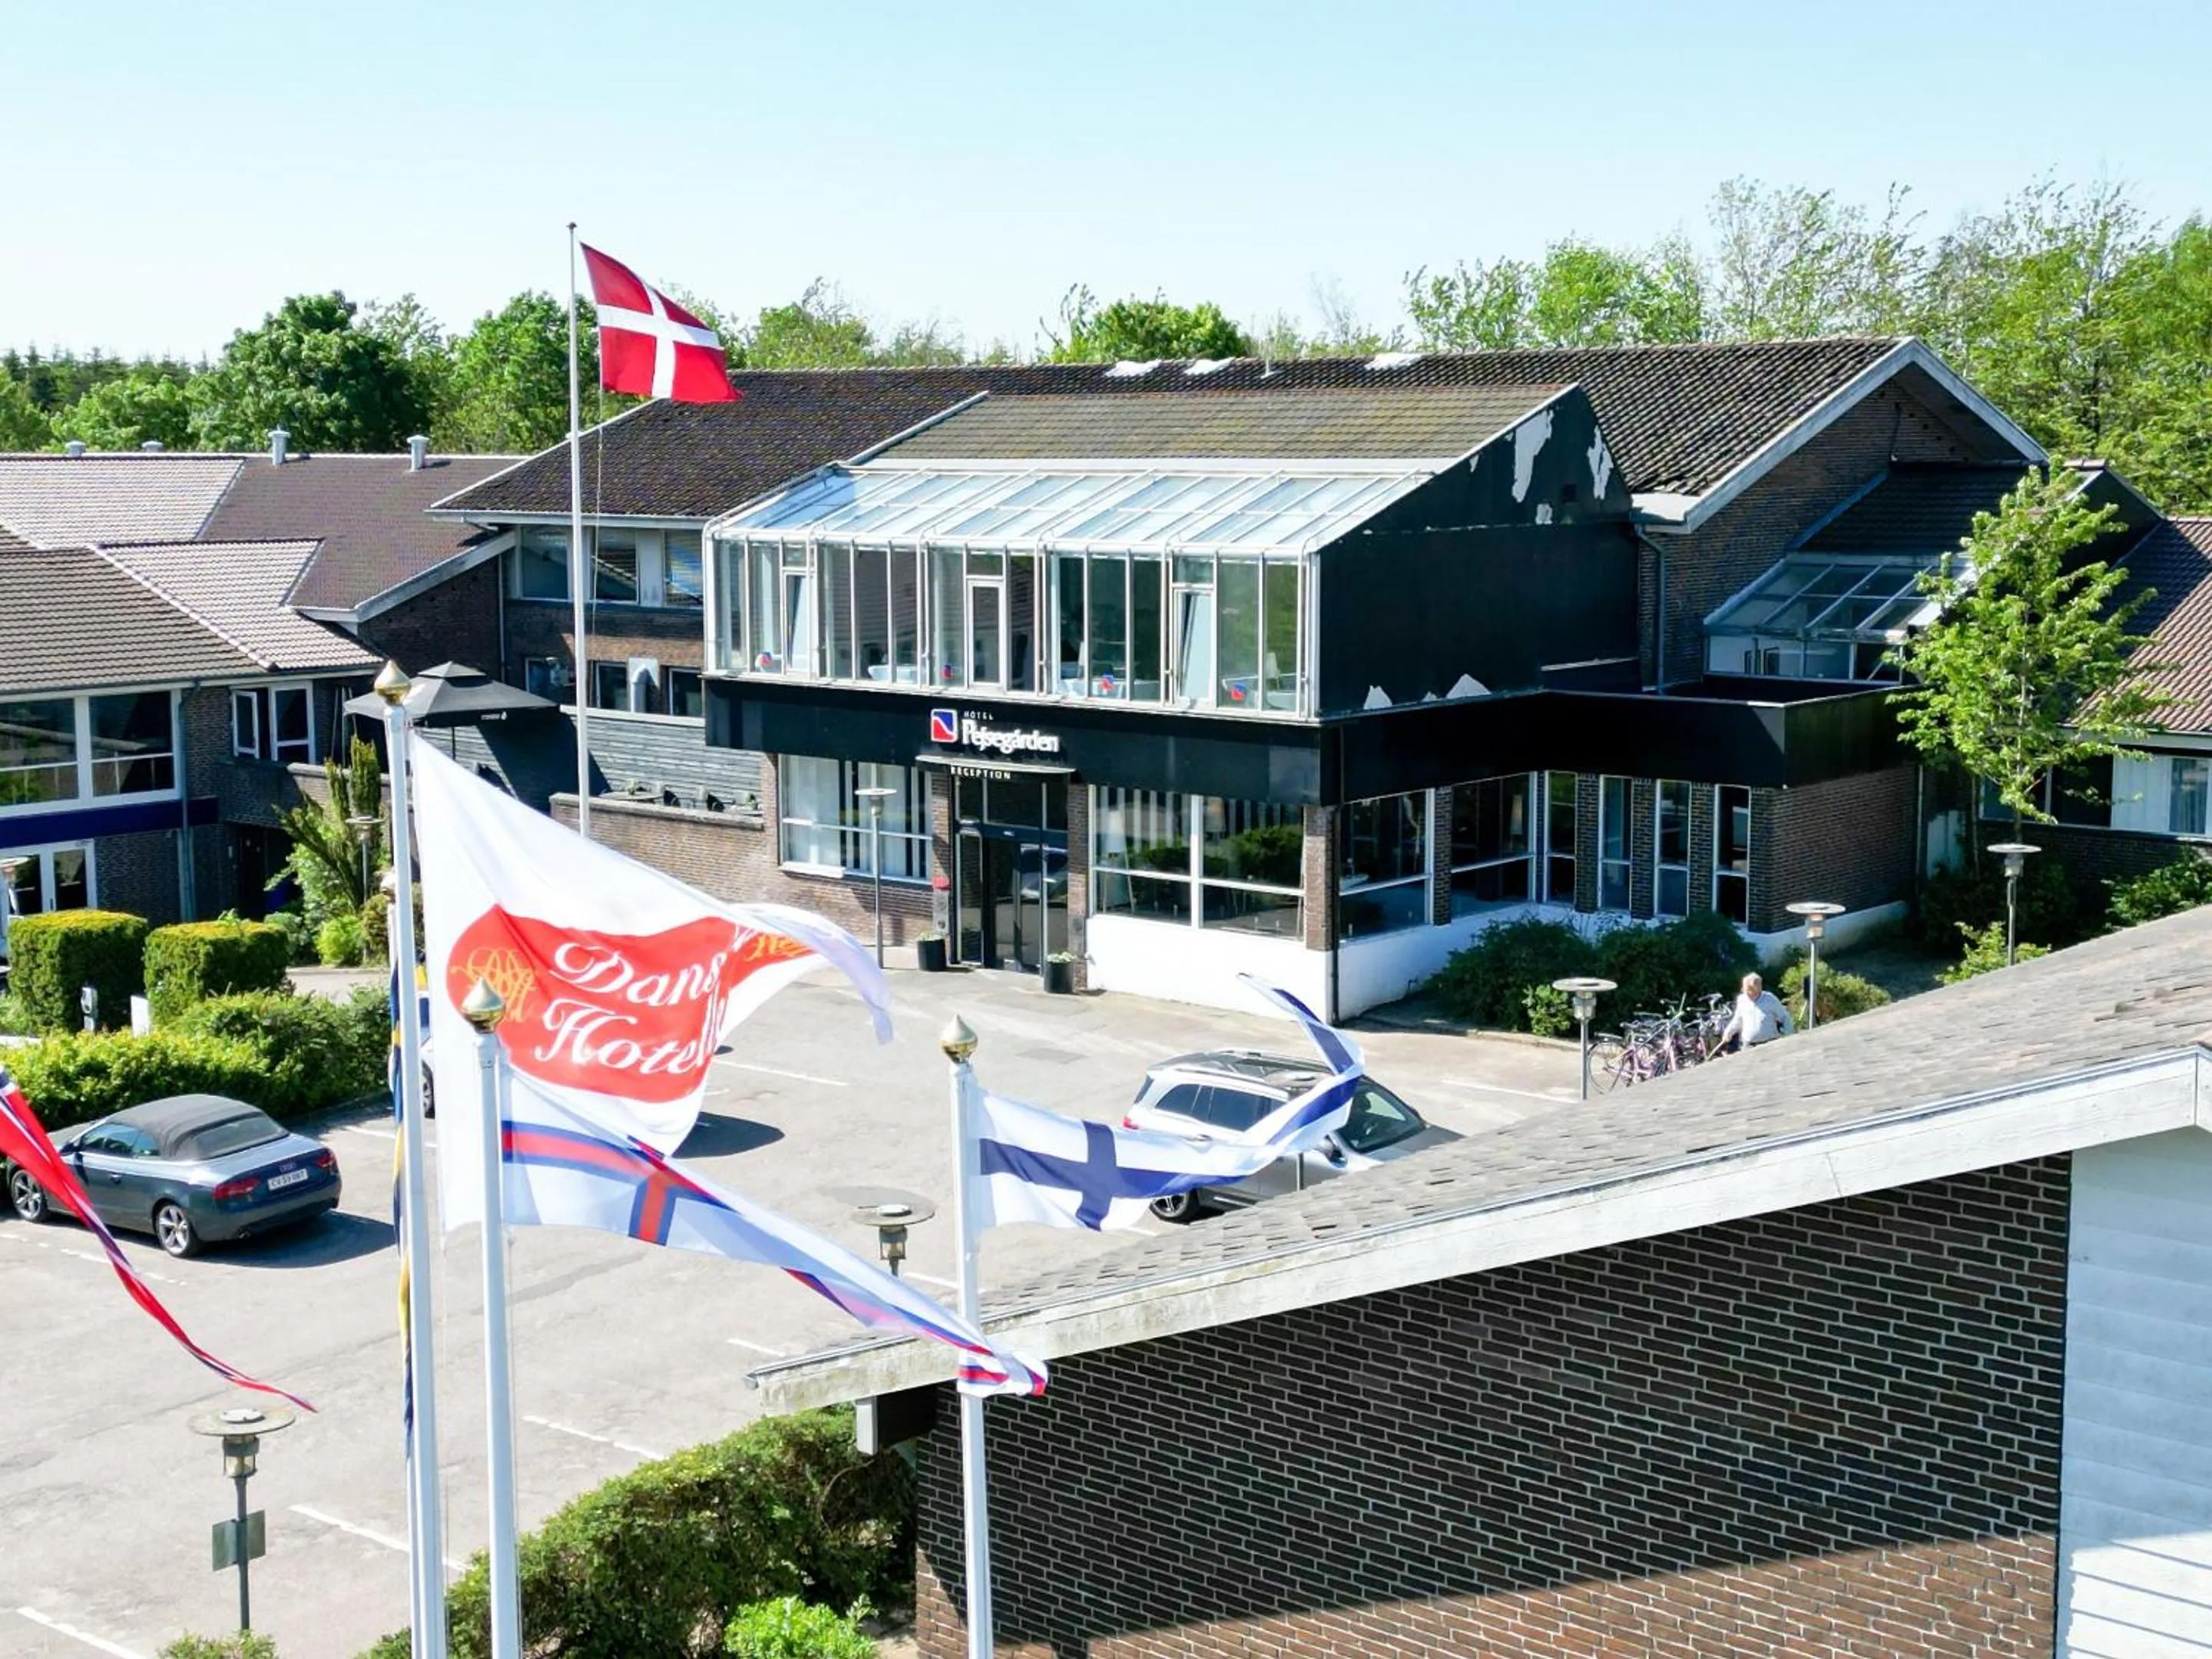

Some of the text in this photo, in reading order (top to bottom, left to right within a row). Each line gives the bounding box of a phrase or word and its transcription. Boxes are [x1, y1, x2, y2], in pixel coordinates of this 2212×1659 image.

[964, 710, 994, 720] HOTEL
[962, 719, 1059, 754] Pejsegården
[950, 766, 1011, 780] RECEPTION
